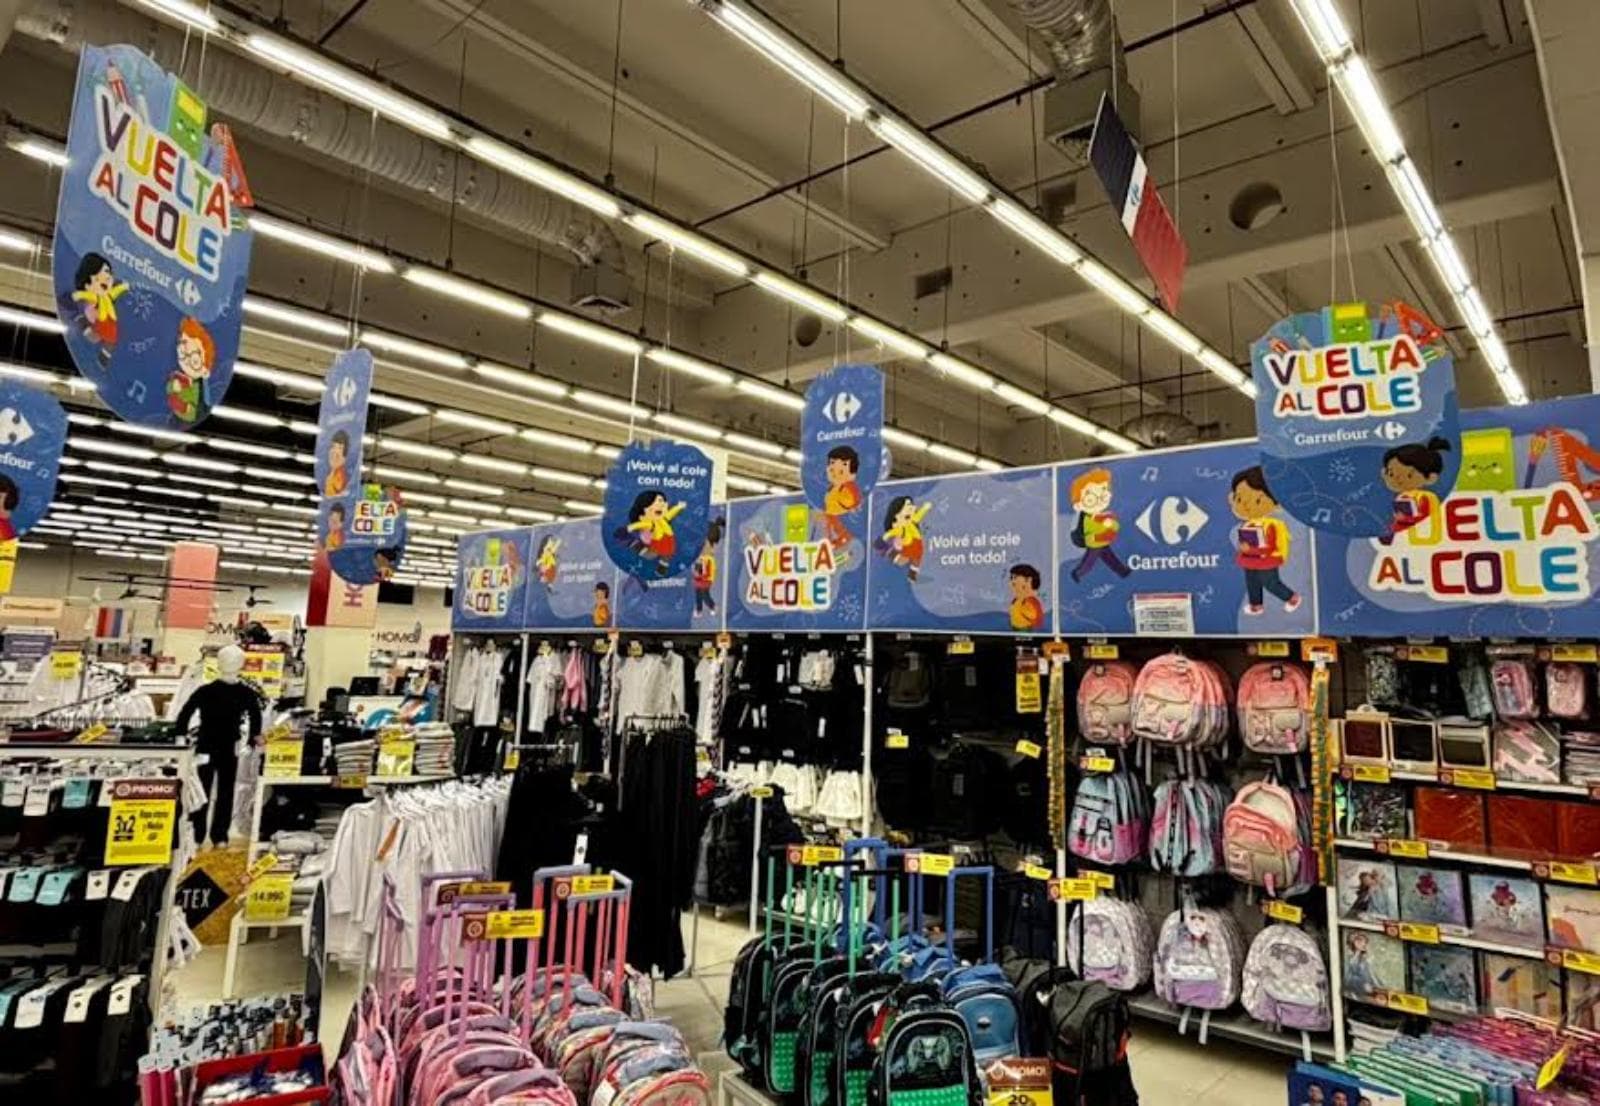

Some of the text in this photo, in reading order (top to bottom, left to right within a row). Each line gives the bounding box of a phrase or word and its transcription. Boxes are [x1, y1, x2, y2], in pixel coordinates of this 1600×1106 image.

[101, 94, 228, 230] VUELTA
[95, 161, 220, 276] AL COLE
[101, 235, 172, 287] Carrefour
[1269, 338, 1420, 386] VUELTA
[1278, 376, 1416, 415] AL COLE
[816, 427, 867, 442] Carrefour
[1294, 427, 1370, 446] Carrefour
[0, 451, 35, 469] four
[627, 459, 708, 476] ¡Volvé al cole
[637, 475, 696, 489] con todo!
[356, 500, 397, 518] ELTA
[1379, 490, 1590, 546] UELTA
[353, 518, 393, 533] COLE
[928, 533, 1021, 551] ¡Volvé al cole
[748, 543, 833, 575] VUELTA
[940, 549, 1007, 565] con todo!
[1127, 552, 1220, 571] Carrefour
[1376, 547, 1581, 595] AL COLE
[749, 577, 828, 605] AL COLE
[475, 592, 506, 613] COLE
[181, 888, 212, 910] TEX
